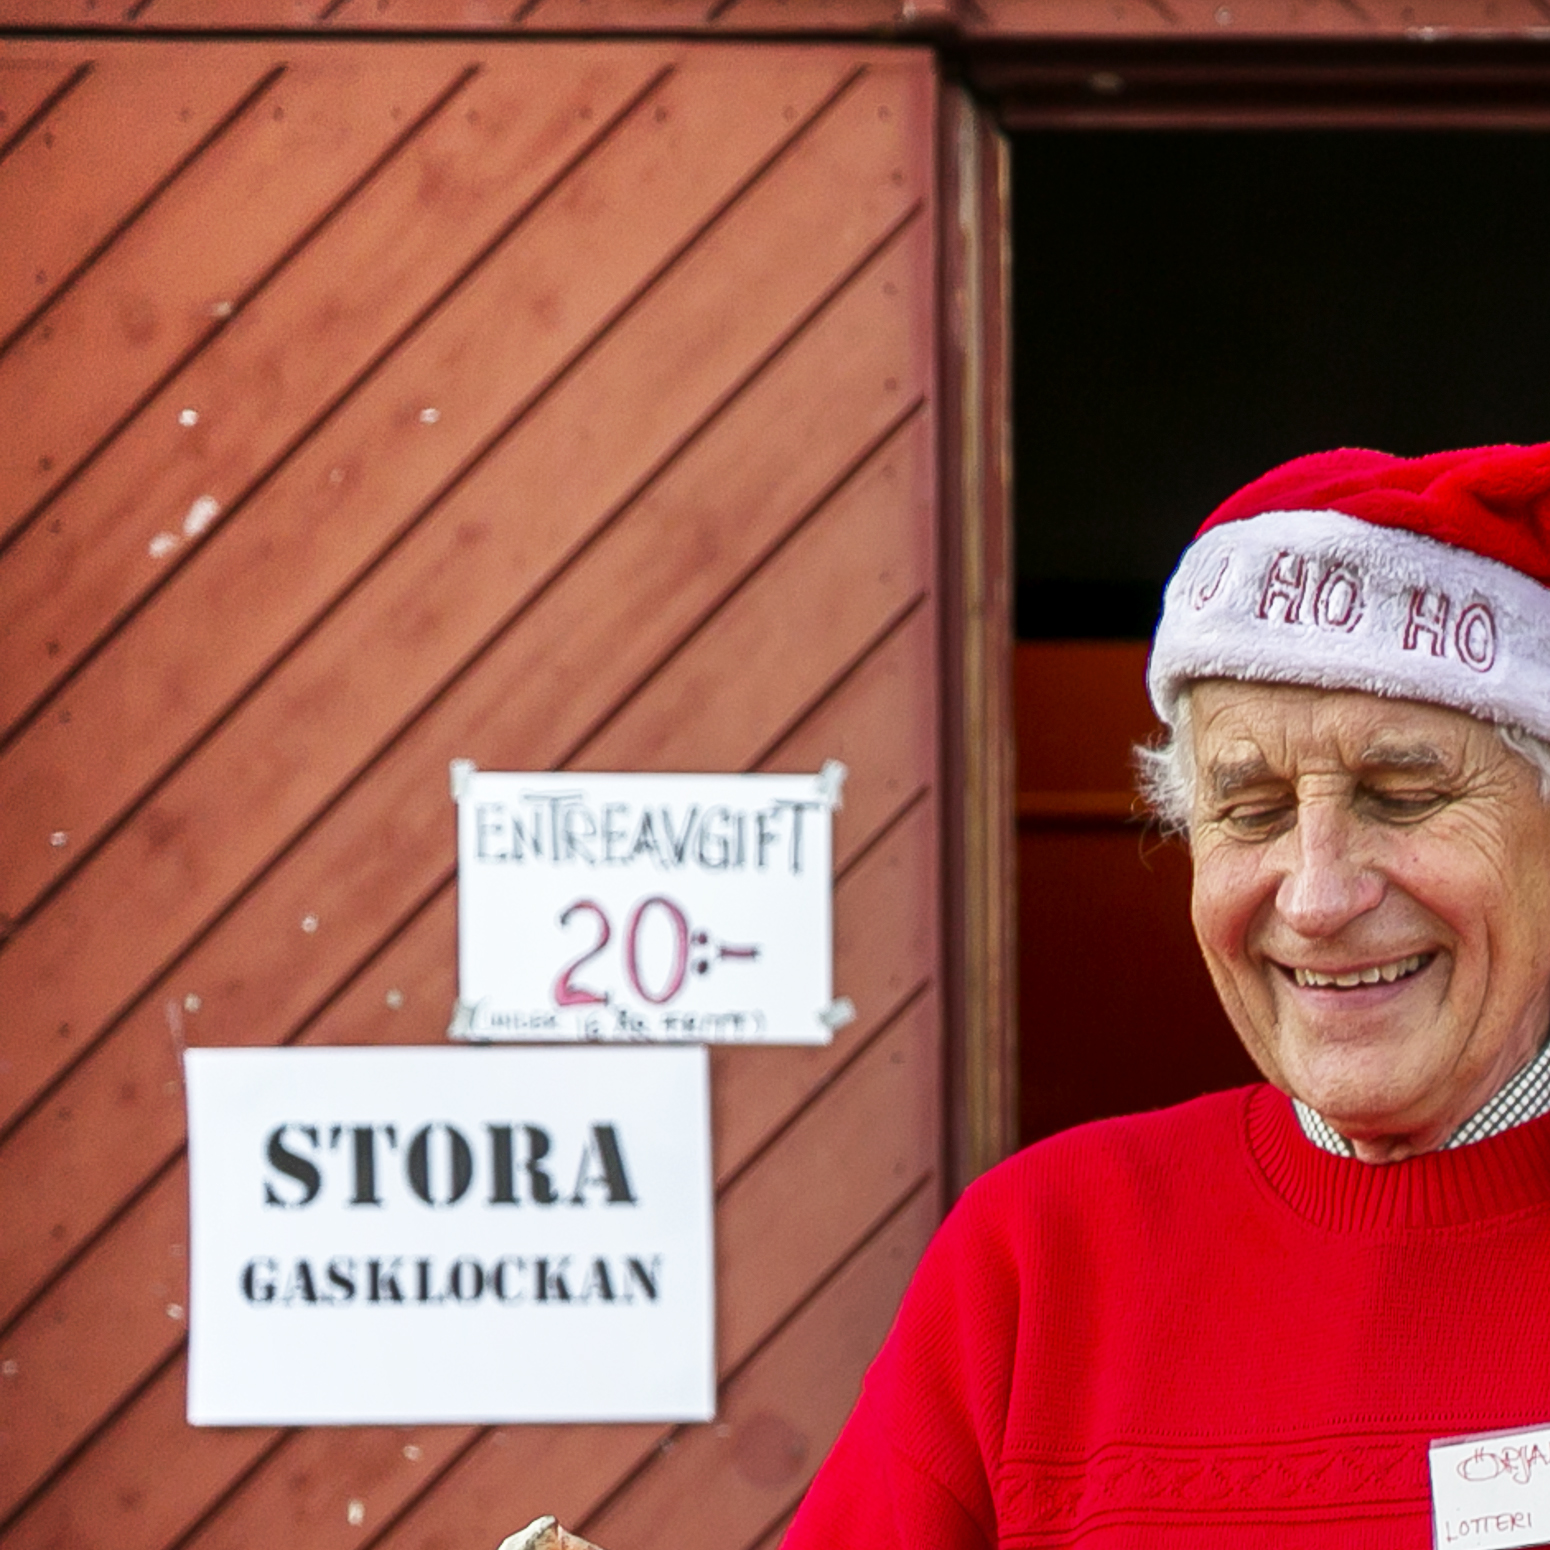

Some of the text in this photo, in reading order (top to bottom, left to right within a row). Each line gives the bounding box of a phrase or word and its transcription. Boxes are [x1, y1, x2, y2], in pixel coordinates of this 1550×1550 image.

[1255, 549, 1365, 635] HO
[1402, 585, 1498, 675] HO
[475, 792, 821, 875] ENTREAVGIFT
[553, 896, 762, 1007] 20:-
[262, 1121, 639, 1210] STORA
[239, 1254, 664, 1308] GASKLOCKAN
[1444, 1511, 1533, 1544] LOTTERI
